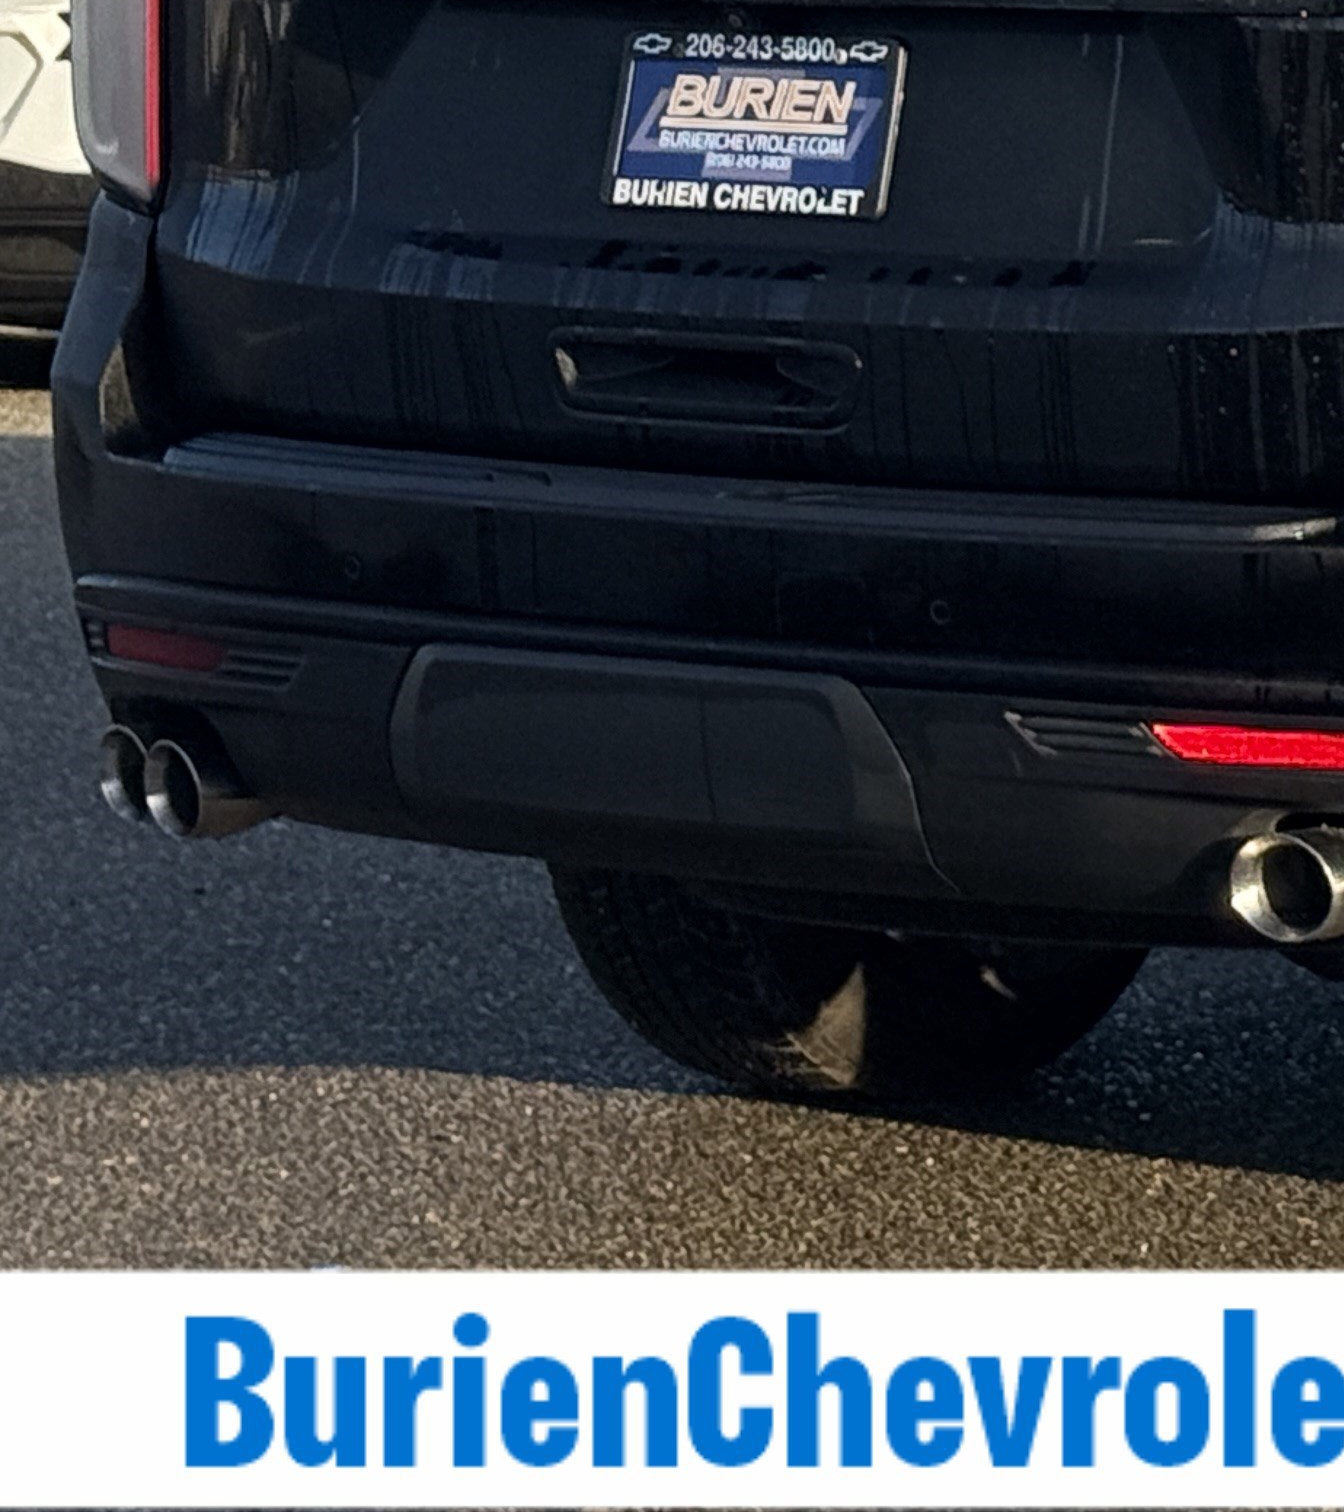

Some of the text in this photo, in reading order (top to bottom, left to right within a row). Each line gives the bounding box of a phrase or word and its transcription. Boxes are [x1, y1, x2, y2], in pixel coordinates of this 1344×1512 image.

[685, 32, 837, 63] 206-243-5800
[665, 73, 857, 124] BURIEN
[658, 128, 847, 156] BURIENCHEVROLET.COM
[612, 177, 865, 216] BURIEN CHEVROLET
